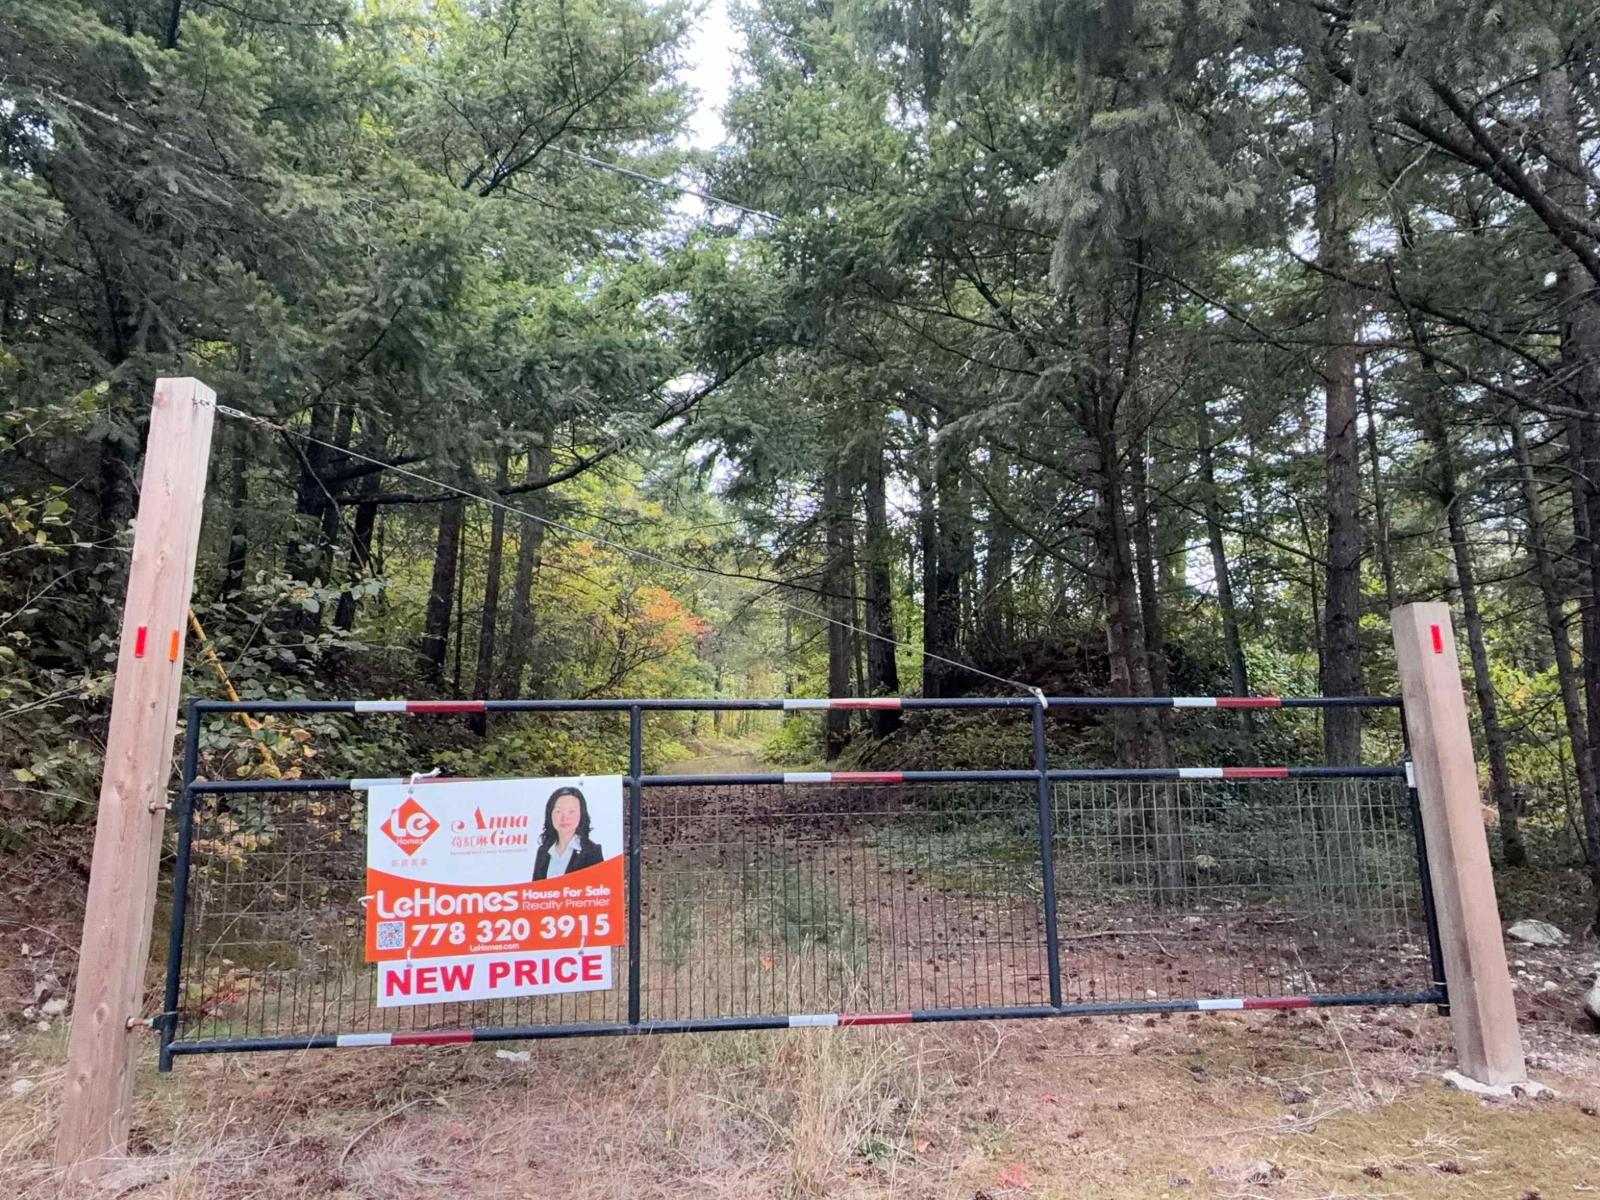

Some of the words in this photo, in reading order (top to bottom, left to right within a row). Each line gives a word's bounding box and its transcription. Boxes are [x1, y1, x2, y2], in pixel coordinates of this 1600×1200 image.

[391, 809, 430, 837] Le
[451, 806, 528, 832] Anna
[396, 837, 424, 845] Homes
[377, 887, 519, 919] LeHomes
[522, 889, 561, 900] House
[563, 887, 582, 898] For
[585, 884, 611, 897] Sale
[522, 900, 563, 911] Realty
[565, 898, 610, 908] Premier
[411, 921, 466, 947] 778
[476, 917, 530, 943] 320
[540, 914, 610, 939] 3915
[469, 943, 520, 952] LeHomes.com
[386, 964, 475, 997] NEW
[489, 955, 603, 988] PRICE
